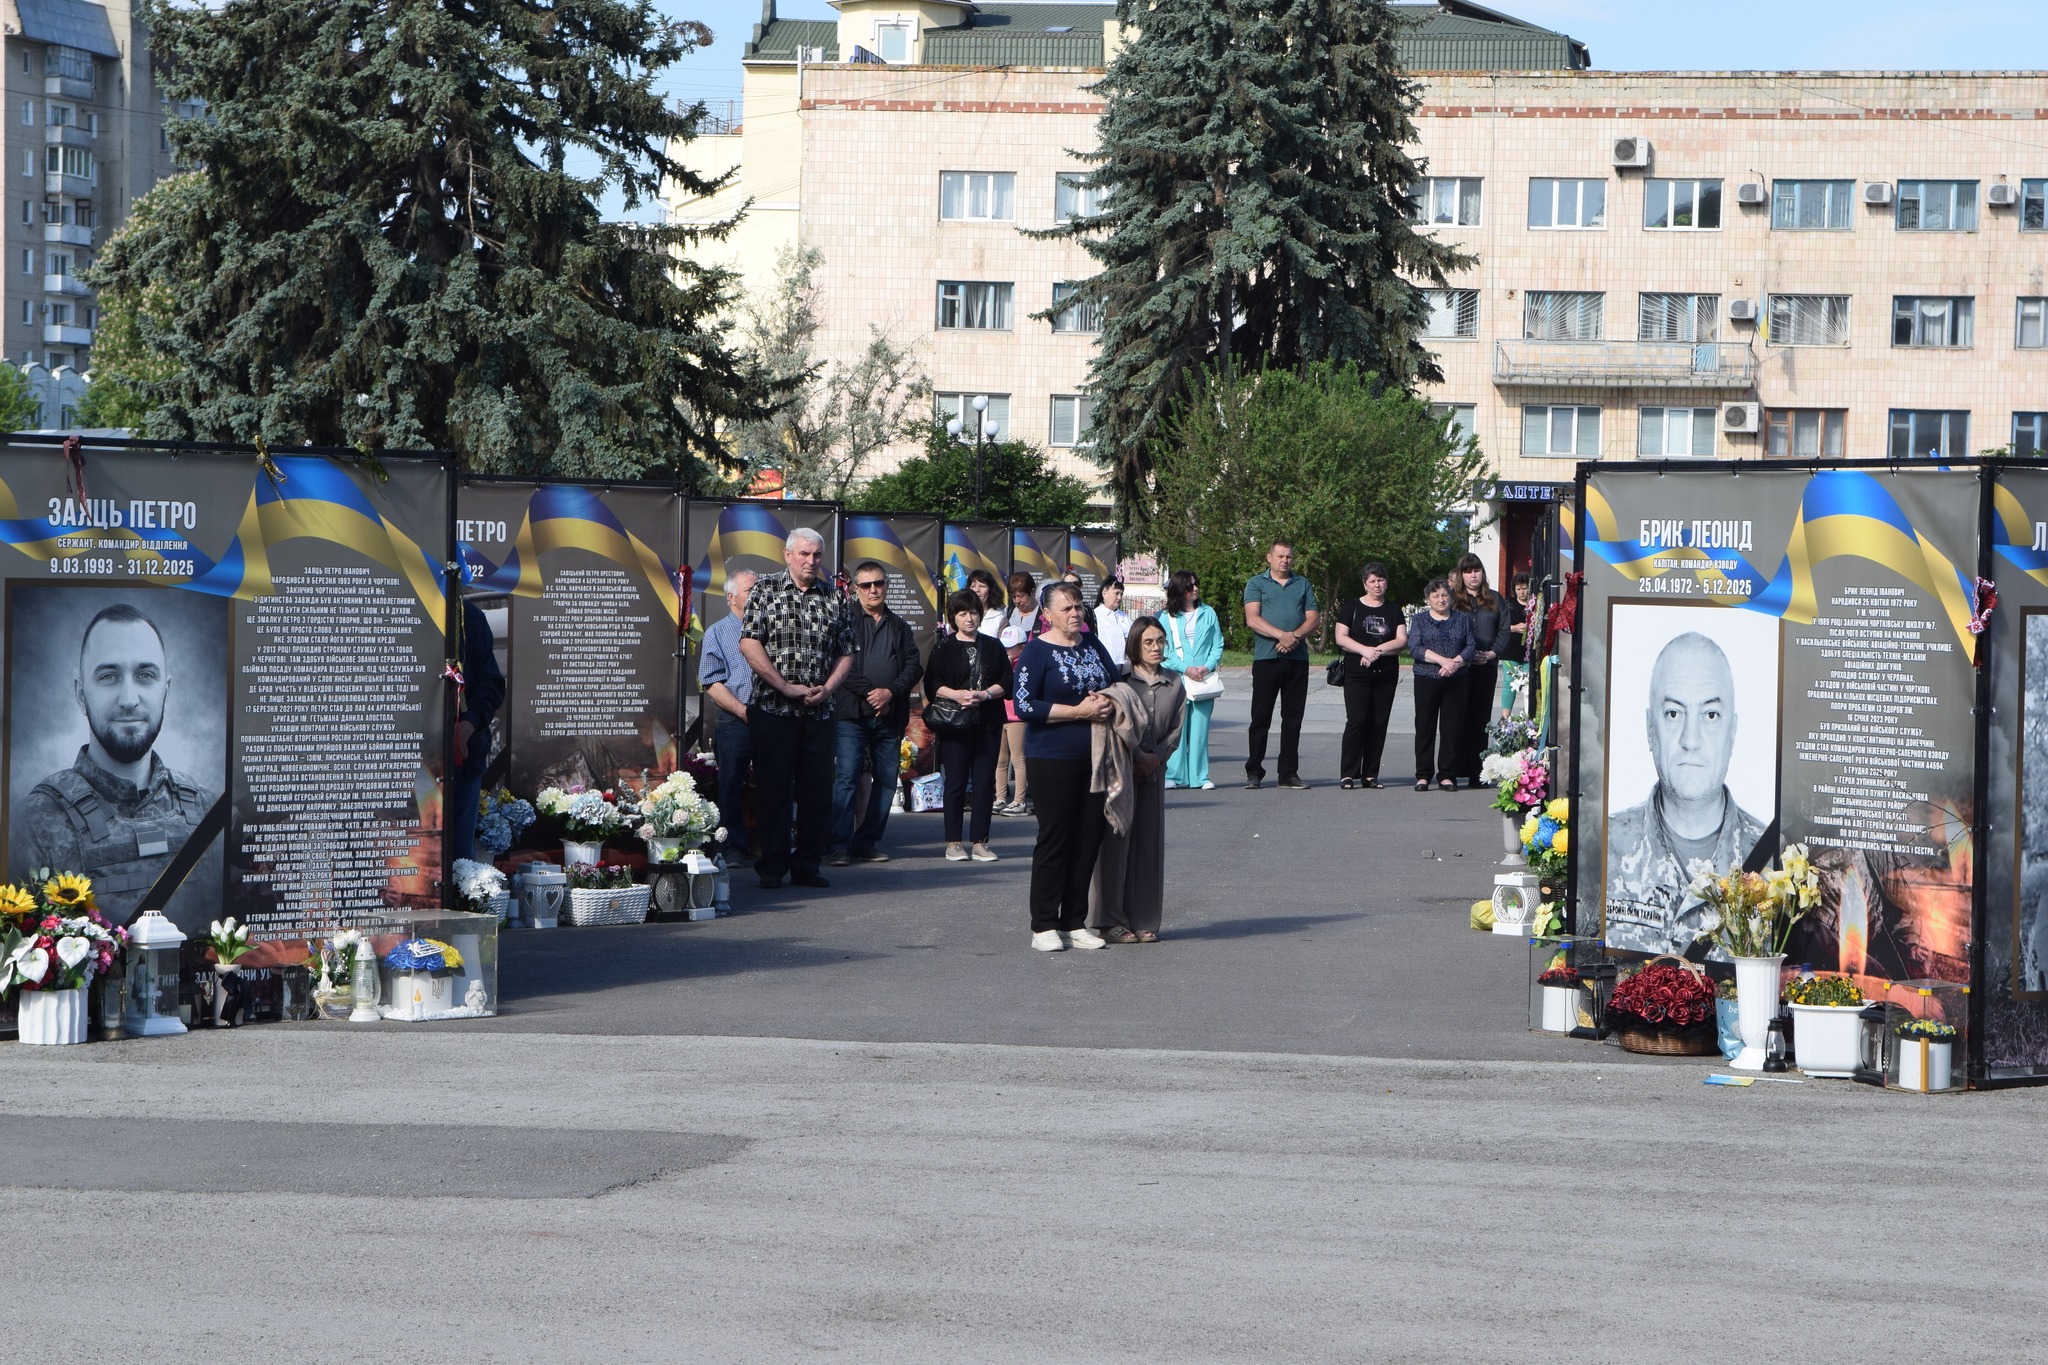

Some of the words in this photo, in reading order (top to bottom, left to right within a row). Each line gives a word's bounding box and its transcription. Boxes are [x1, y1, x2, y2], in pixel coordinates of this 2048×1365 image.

[1502, 486, 1554, 499] АПТЕ
[49, 498, 122, 529] ЗАЯЦЬ
[130, 500, 196, 529] ПЕТРО
[456, 520, 506, 542] ПЕТРО
[1640, 520, 1683, 548] БРИК
[1689, 520, 1752, 551] ЛЕОНІД
[57, 538, 96, 549] СЕРЖАНТ,
[98, 539, 139, 550] КОМАНДИР
[142, 540, 187, 550] ВІДДІЛЕННЯ
[50, 558, 113, 574] 9.03.1993
[128, 559, 194, 575] 31.12.2025
[1653, 559, 1679, 569] КАПІТАН,
[1681, 559, 1713, 569] КОМАНДИР
[1714, 560, 1738, 570] ВЗВОДУ
[271, 576, 304, 584] НАРОДИВСЯ
[311, 576, 336, 584] БЕРЕЗНЯ
[286, 586, 313, 594] ЗАКІНЧИВ
[314, 586, 355, 594] ЧОРТКІВСЬКИЙ
[357, 586, 373, 594] ЛІЦЕЙ
[1639, 577, 1692, 593] 25.04.1972
[1703, 579, 1751, 595] 5.12.2025
[294, 596, 318, 604] ЗАВЖДИ
[320, 596, 331, 604] БУВ
[242, 664, 267, 673] ОБІЙМАВ
[268, 665, 291, 673] ПОСАДУ
[293, 665, 327, 673] КОМАНДИРА
[257, 674, 310, 683] КОМАНДИРОВАНИЙ
[353, 674, 384, 682] ДОНЕЦЬКОЇ
[309, 714, 338, 722] ГЕТЬМАНА
[339, 723, 369, 731] ВІЙСЬКОВУ
[240, 734, 292, 742] ПОВНОМАСШТАБНЕ
[294, 734, 329, 742] ВТОРГНЕННЯ
[352, 733, 374, 741] ЗУСТРІВ
[384, 733, 401, 741] СХОДІ
[266, 803, 304, 811] ДОНЕЦЬКОМУ
[339, 801, 382, 810] ЗАБЕЗПЕЧУЮЧИ
[315, 890, 332, 898] ВОЇНА
[343, 888, 356, 897] АЛЕЇ
[358, 887, 378, 897] ГЕРОЇВ
